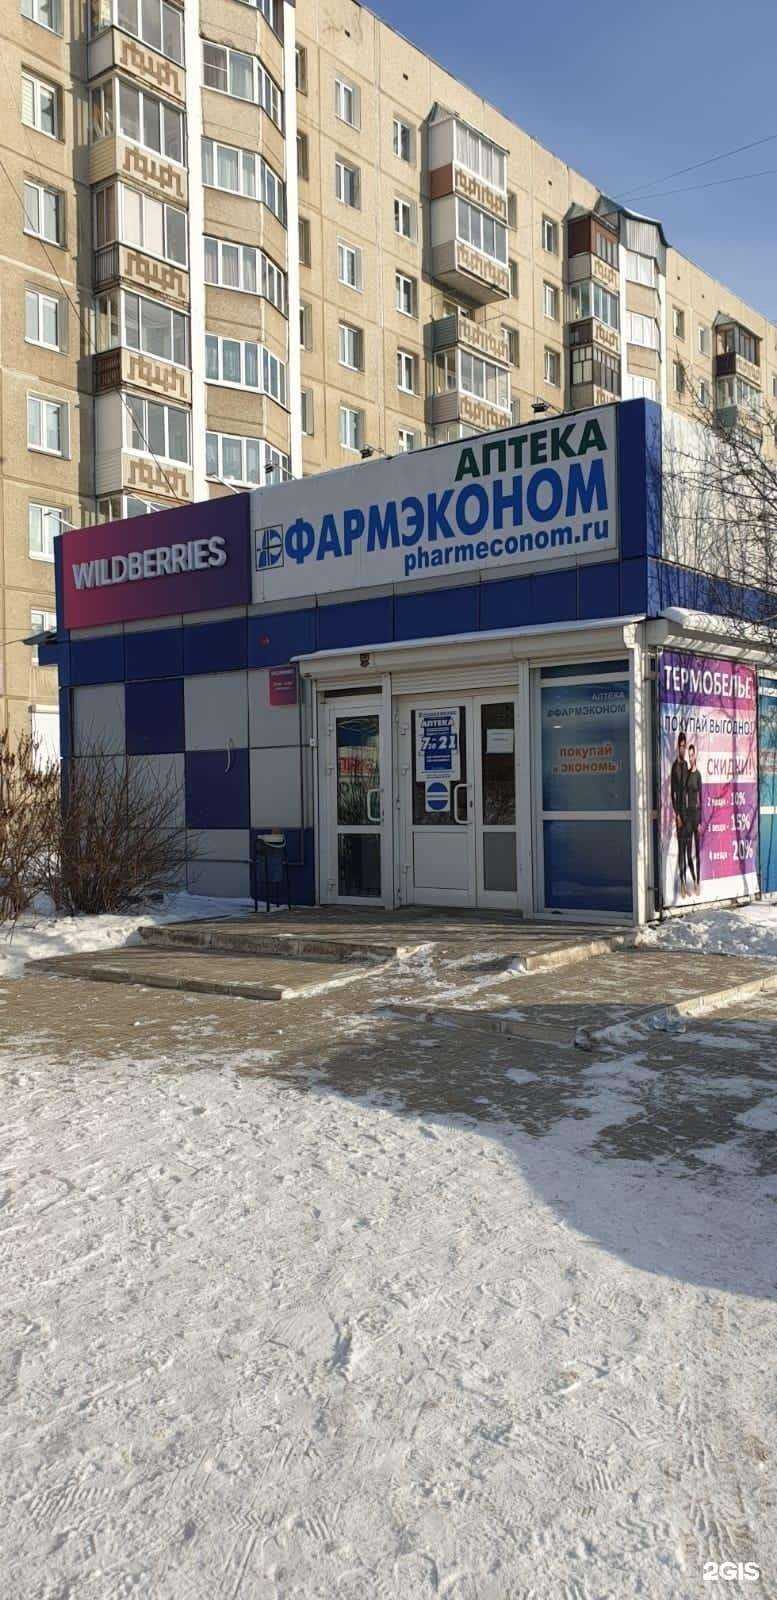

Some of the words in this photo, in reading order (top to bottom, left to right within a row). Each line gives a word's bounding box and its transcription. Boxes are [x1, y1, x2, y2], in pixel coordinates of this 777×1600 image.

[454, 418, 608, 481] АПТЕКА
[285, 458, 609, 564] ФАРМЭКОНОМ
[72, 536, 227, 590] WILDBERRIES
[404, 519, 609, 576] pharmeconom.ru
[664, 664, 754, 699] ТЕРМОБЕЛЬЕ
[664, 714, 707, 734] ПОКУПАЙ
[730, 791, 746, 806] 10%
[731, 813, 751, 832] 15%
[732, 839, 754, 862] 20%
